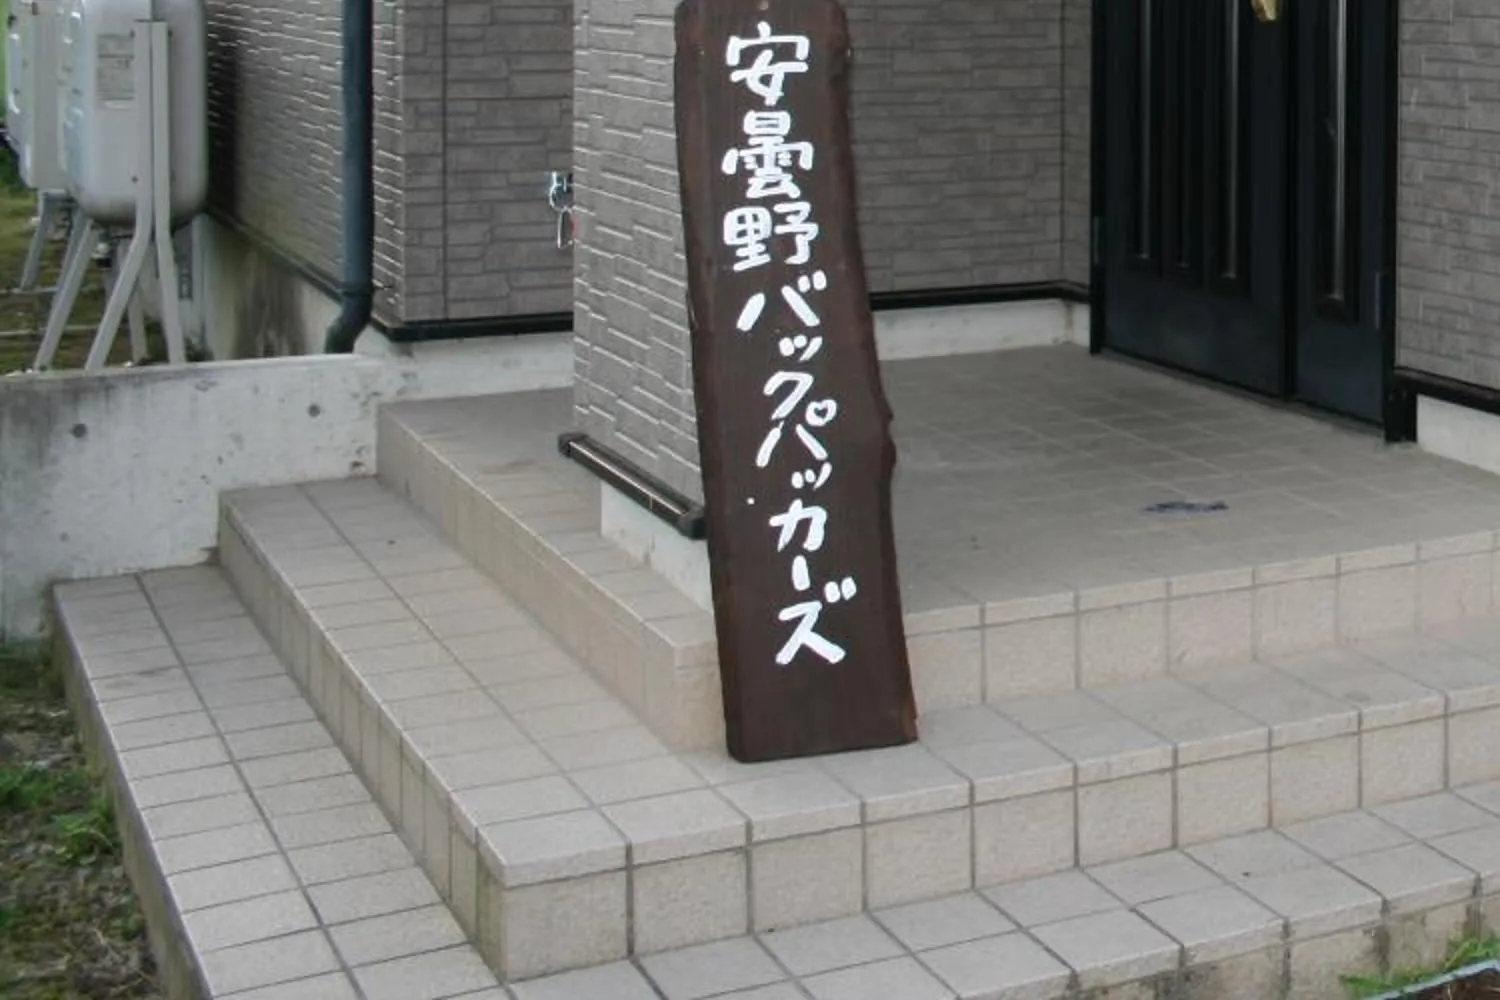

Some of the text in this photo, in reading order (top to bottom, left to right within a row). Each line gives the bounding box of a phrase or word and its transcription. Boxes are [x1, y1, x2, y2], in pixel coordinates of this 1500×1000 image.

[720, 20, 858, 666] 安曇野バックパッカーズ
